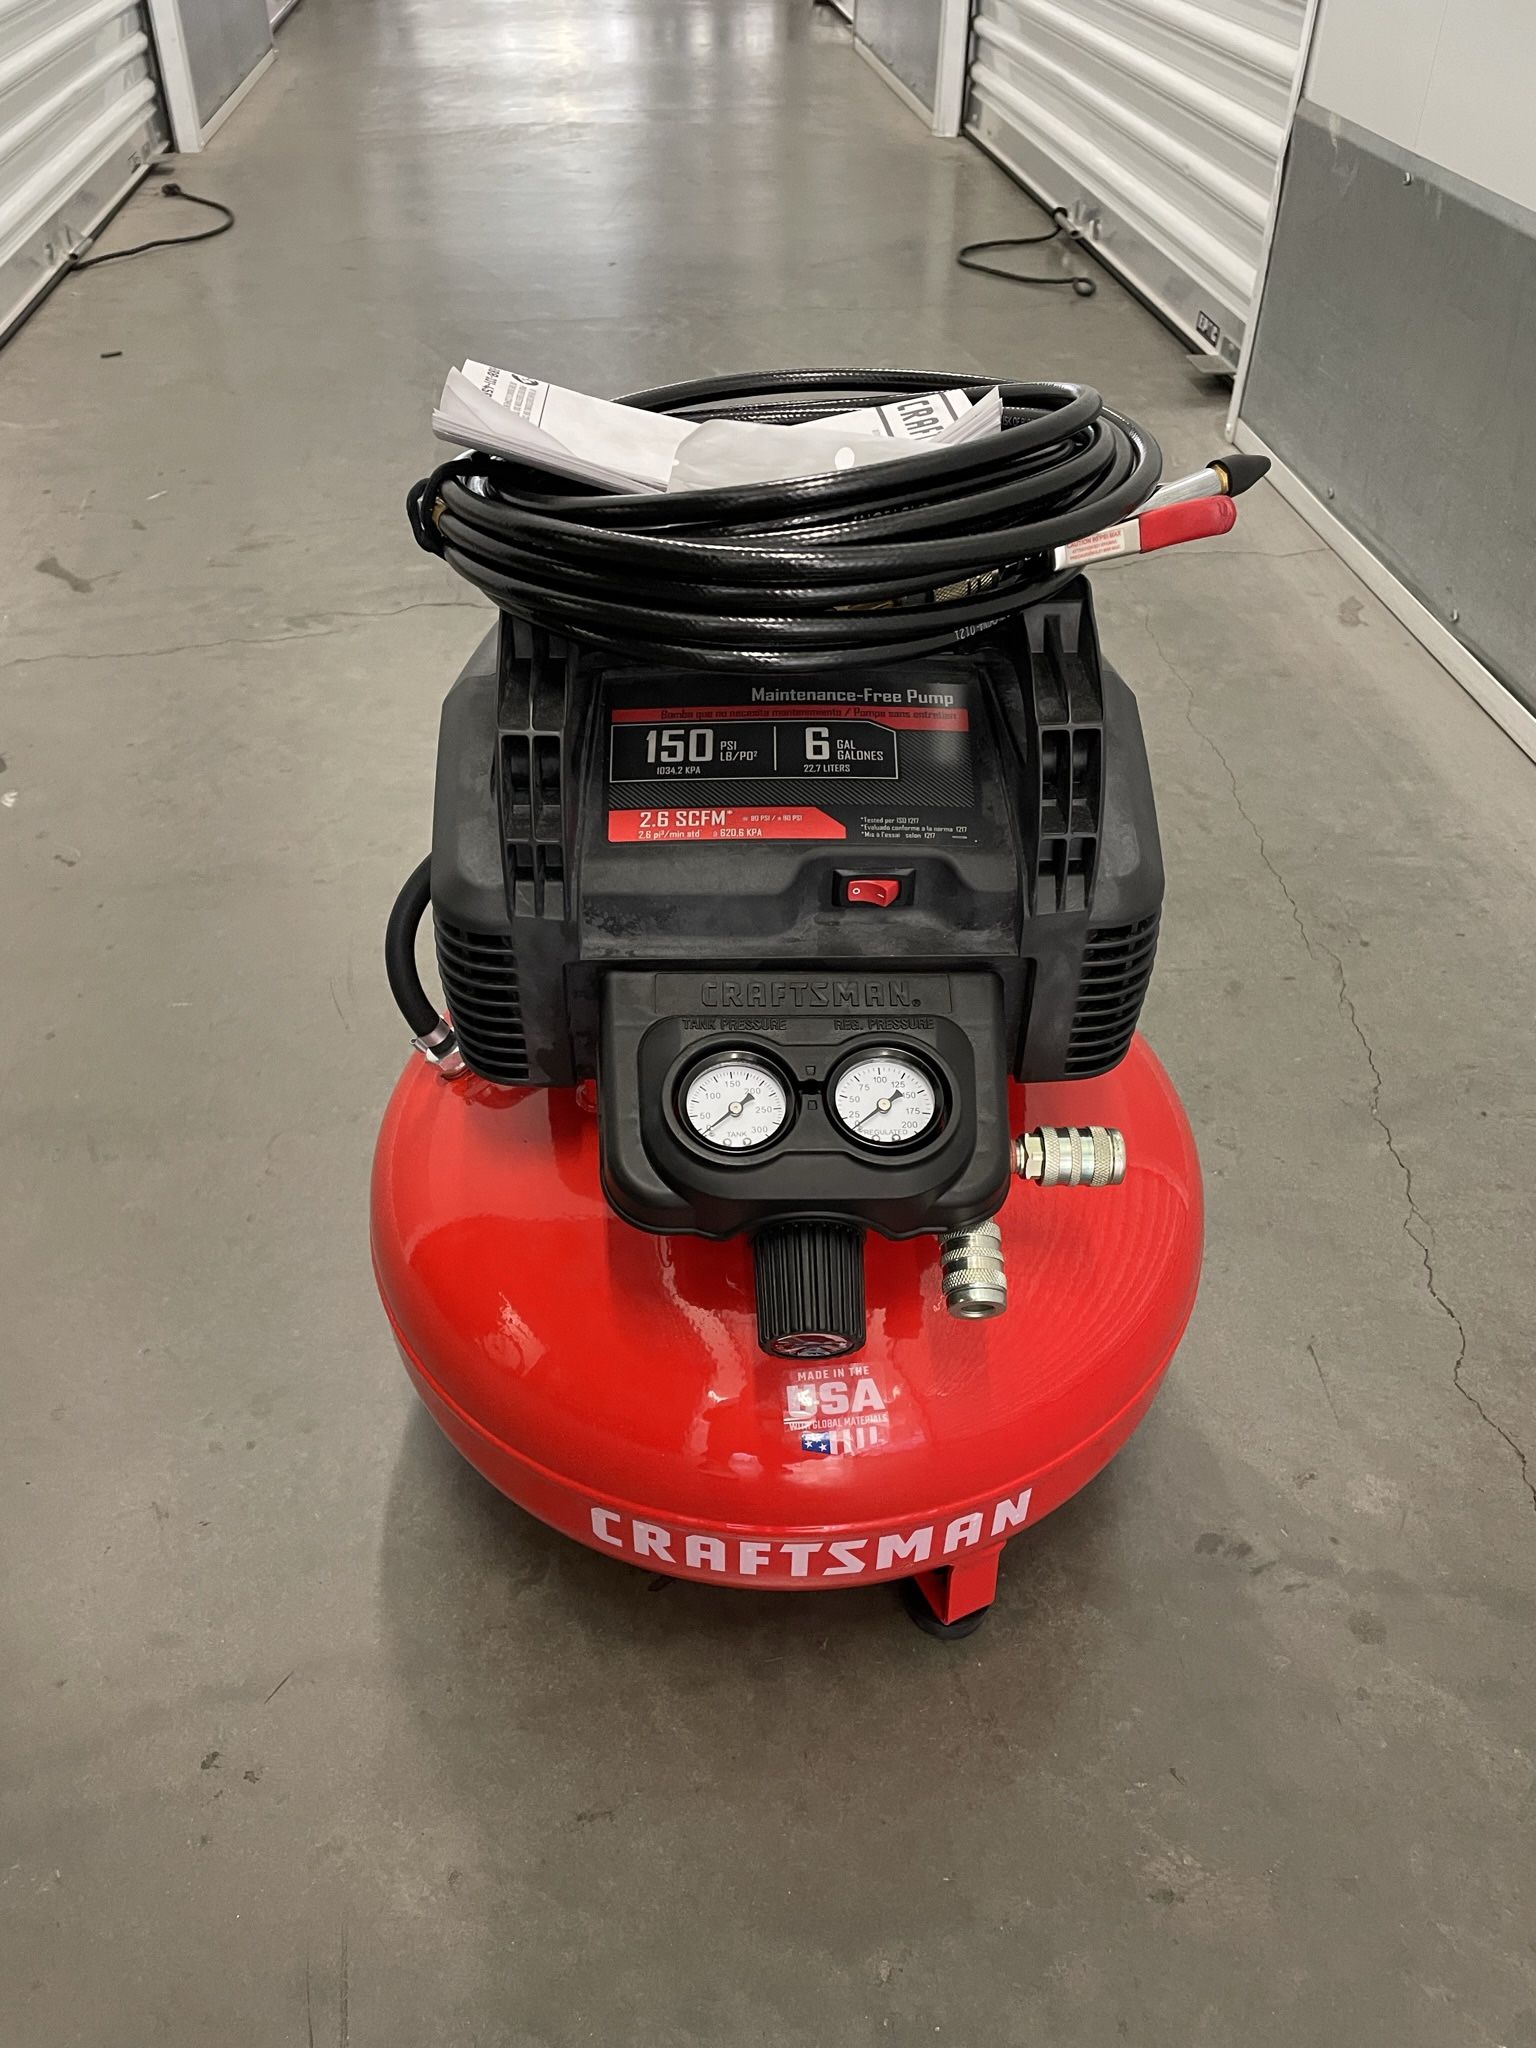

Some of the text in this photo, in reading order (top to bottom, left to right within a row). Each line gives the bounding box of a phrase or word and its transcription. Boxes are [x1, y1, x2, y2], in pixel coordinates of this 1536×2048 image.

[751, 687, 954, 707] Maintenance-Free Pump
[646, 728, 714, 763] 150
[720, 740, 737, 751] PSI
[805, 726, 830, 760] 6
[837, 739, 856, 750] GAL
[837, 750, 884, 761] GALONES
[656, 766, 701, 775] 1034.2 KPA
[803, 764, 851, 773] 22.7 LITERS
[639, 811, 669, 828] 2.6
[638, 830, 651, 839] 2.6
[720, 828, 745, 838] 620.6
[746, 828, 762, 837] KPA
[682, 1018, 788, 1031] TANK PRESSURE
[833, 1017, 935, 1031] REG. PRESSURE
[724, 1080, 741, 1088] 150
[873, 1076, 887, 1084] 100
[859, 1084, 870, 1092] 75
[891, 1081, 906, 1089] 125
[744, 1087, 761, 1095] 200
[705, 1092, 721, 1100] 100
[848, 1095, 860, 1103] 50
[755, 1105, 773, 1114] 250
[848, 1110, 860, 1118] 25
[906, 1107, 921, 1115] 175
[699, 1112, 711, 1120] 50
[901, 1120, 918, 1129] 200
[751, 1126, 768, 1134] 300
[864, 1128, 908, 1136] REGULATED
[797, 1365, 870, 1381] MADE IN THE
[785, 1377, 887, 1419] USA
[812, 1417, 842, 1430] GLOBAL
[844, 1413, 889, 1427] MATERIALS
[590, 1487, 1034, 1577] CRAFTSMAN
